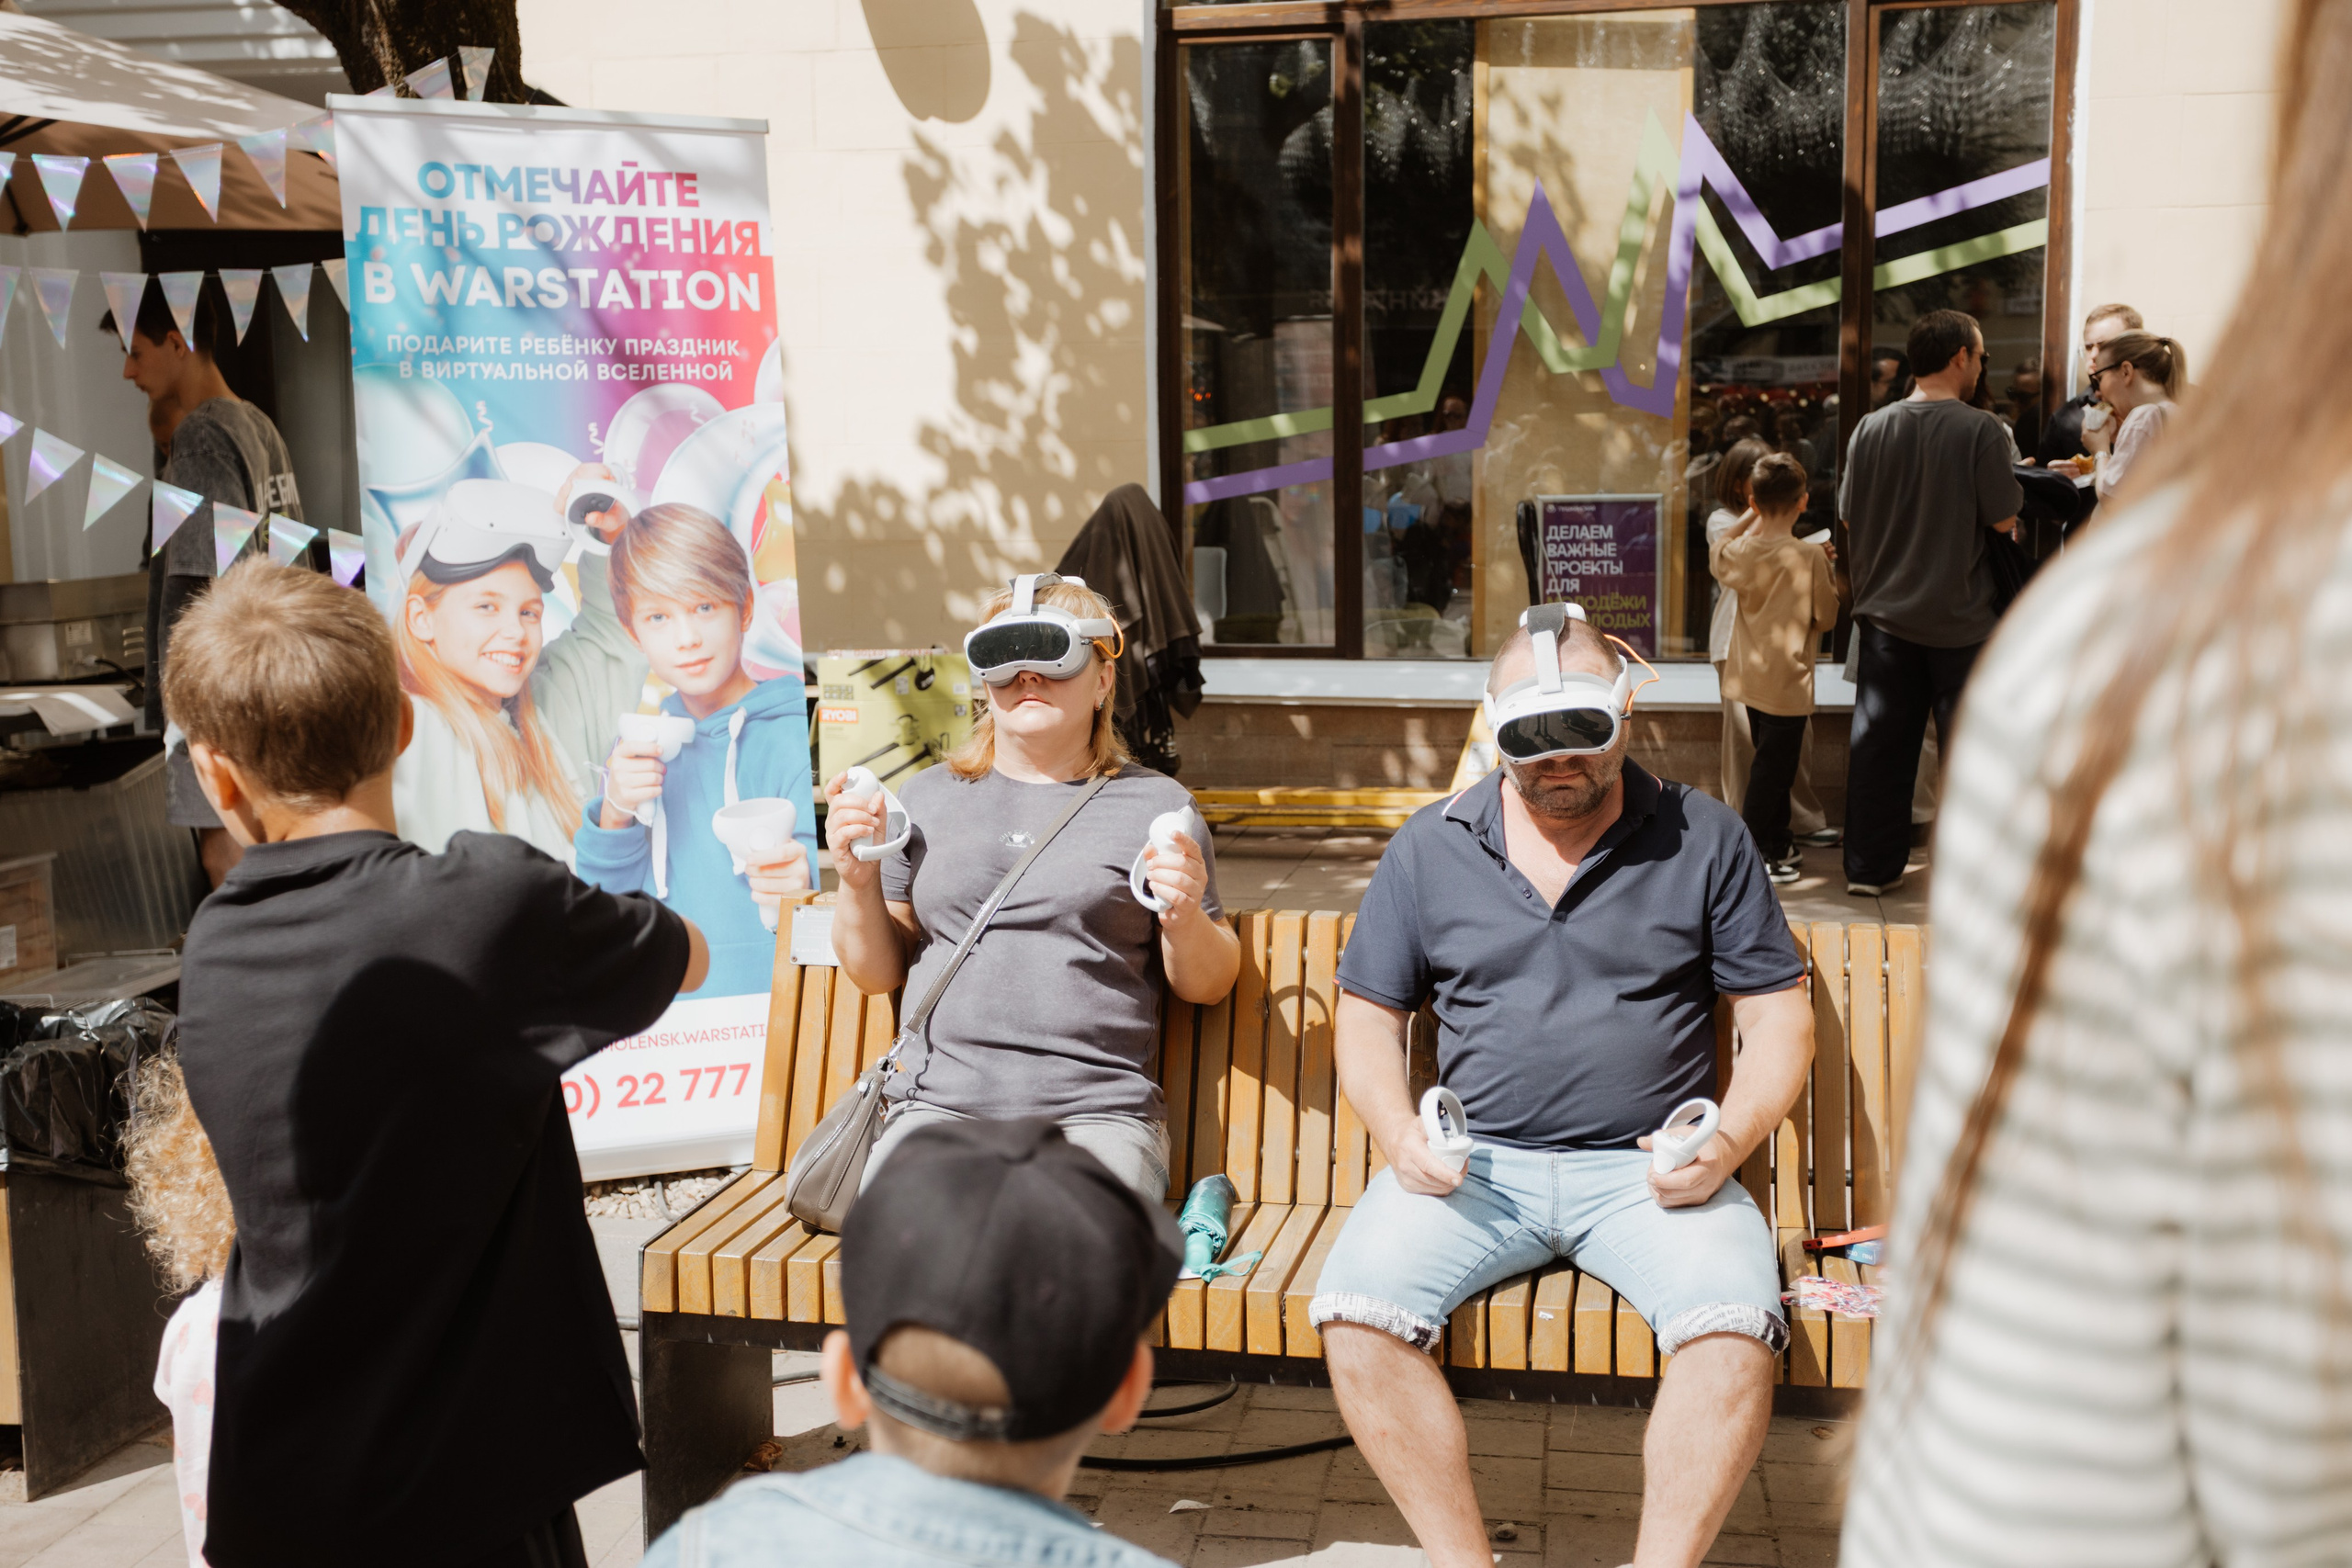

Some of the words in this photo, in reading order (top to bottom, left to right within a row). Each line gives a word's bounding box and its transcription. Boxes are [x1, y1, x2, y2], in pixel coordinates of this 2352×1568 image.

[417, 160, 700, 208] ОТМЕЧАЙТЕ
[356, 206, 485, 248] ДЕНЬ
[497, 212, 761, 256] РОЖДЕНИЯ
[364, 261, 396, 304] В
[410, 263, 761, 312] WARSTATION
[387, 334, 512, 355] ПОДАРИТЕ
[520, 333, 617, 356] РЕБЁНКУ
[625, 338, 740, 358] ПРАЗДНИК
[399, 361, 413, 379] В
[421, 359, 589, 381] ВИРТУАЛЬНОЙ
[597, 360, 733, 381] ВСЕЛЕННОЙ
[1546, 525, 1613, 542] ДЕЛАЕМ
[1546, 543, 1617, 558] ВАЖНЫЕ
[1546, 560, 1623, 576] ПРОЕКТЫ
[1545, 578, 1580, 595] ДЛЯ
[1586, 613, 1651, 630] ЛОДЫХ
[821, 708, 857, 722] RYOBI
[616, 1071, 667, 1109] 22
[679, 1062, 752, 1101] 777
